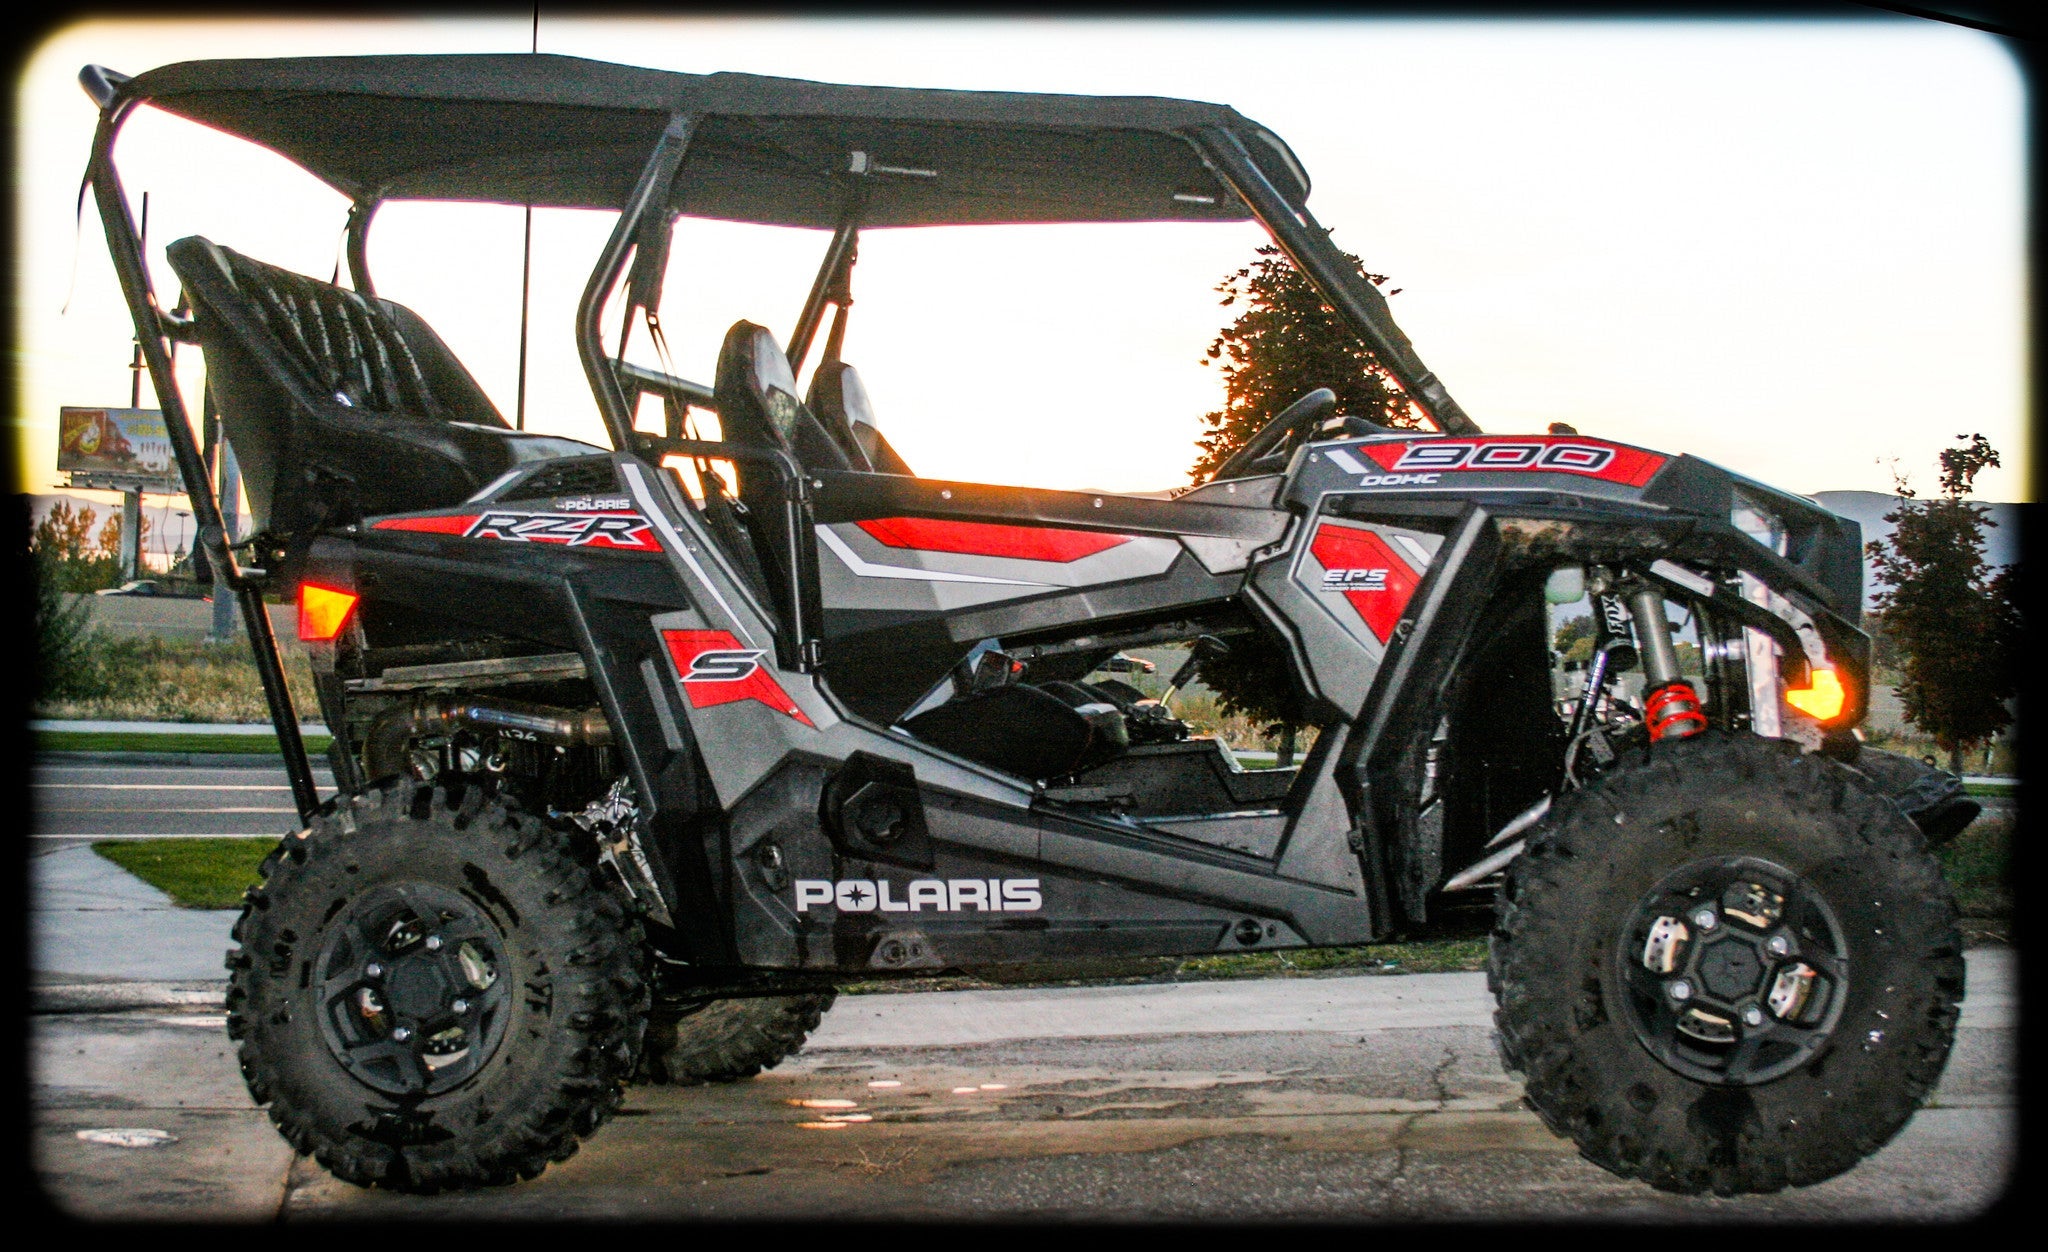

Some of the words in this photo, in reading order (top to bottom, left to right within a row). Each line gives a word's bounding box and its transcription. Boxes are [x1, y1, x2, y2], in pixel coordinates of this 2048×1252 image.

[1392, 443, 1615, 472] 900
[1360, 473, 1441, 487] DOHC
[565, 499, 630, 511] POLARIS
[463, 510, 653, 547] RZR
[1323, 568, 1390, 582] EPS
[1601, 594, 1626, 633] FOX
[679, 649, 769, 682] S
[795, 879, 1042, 912] POLARIS
